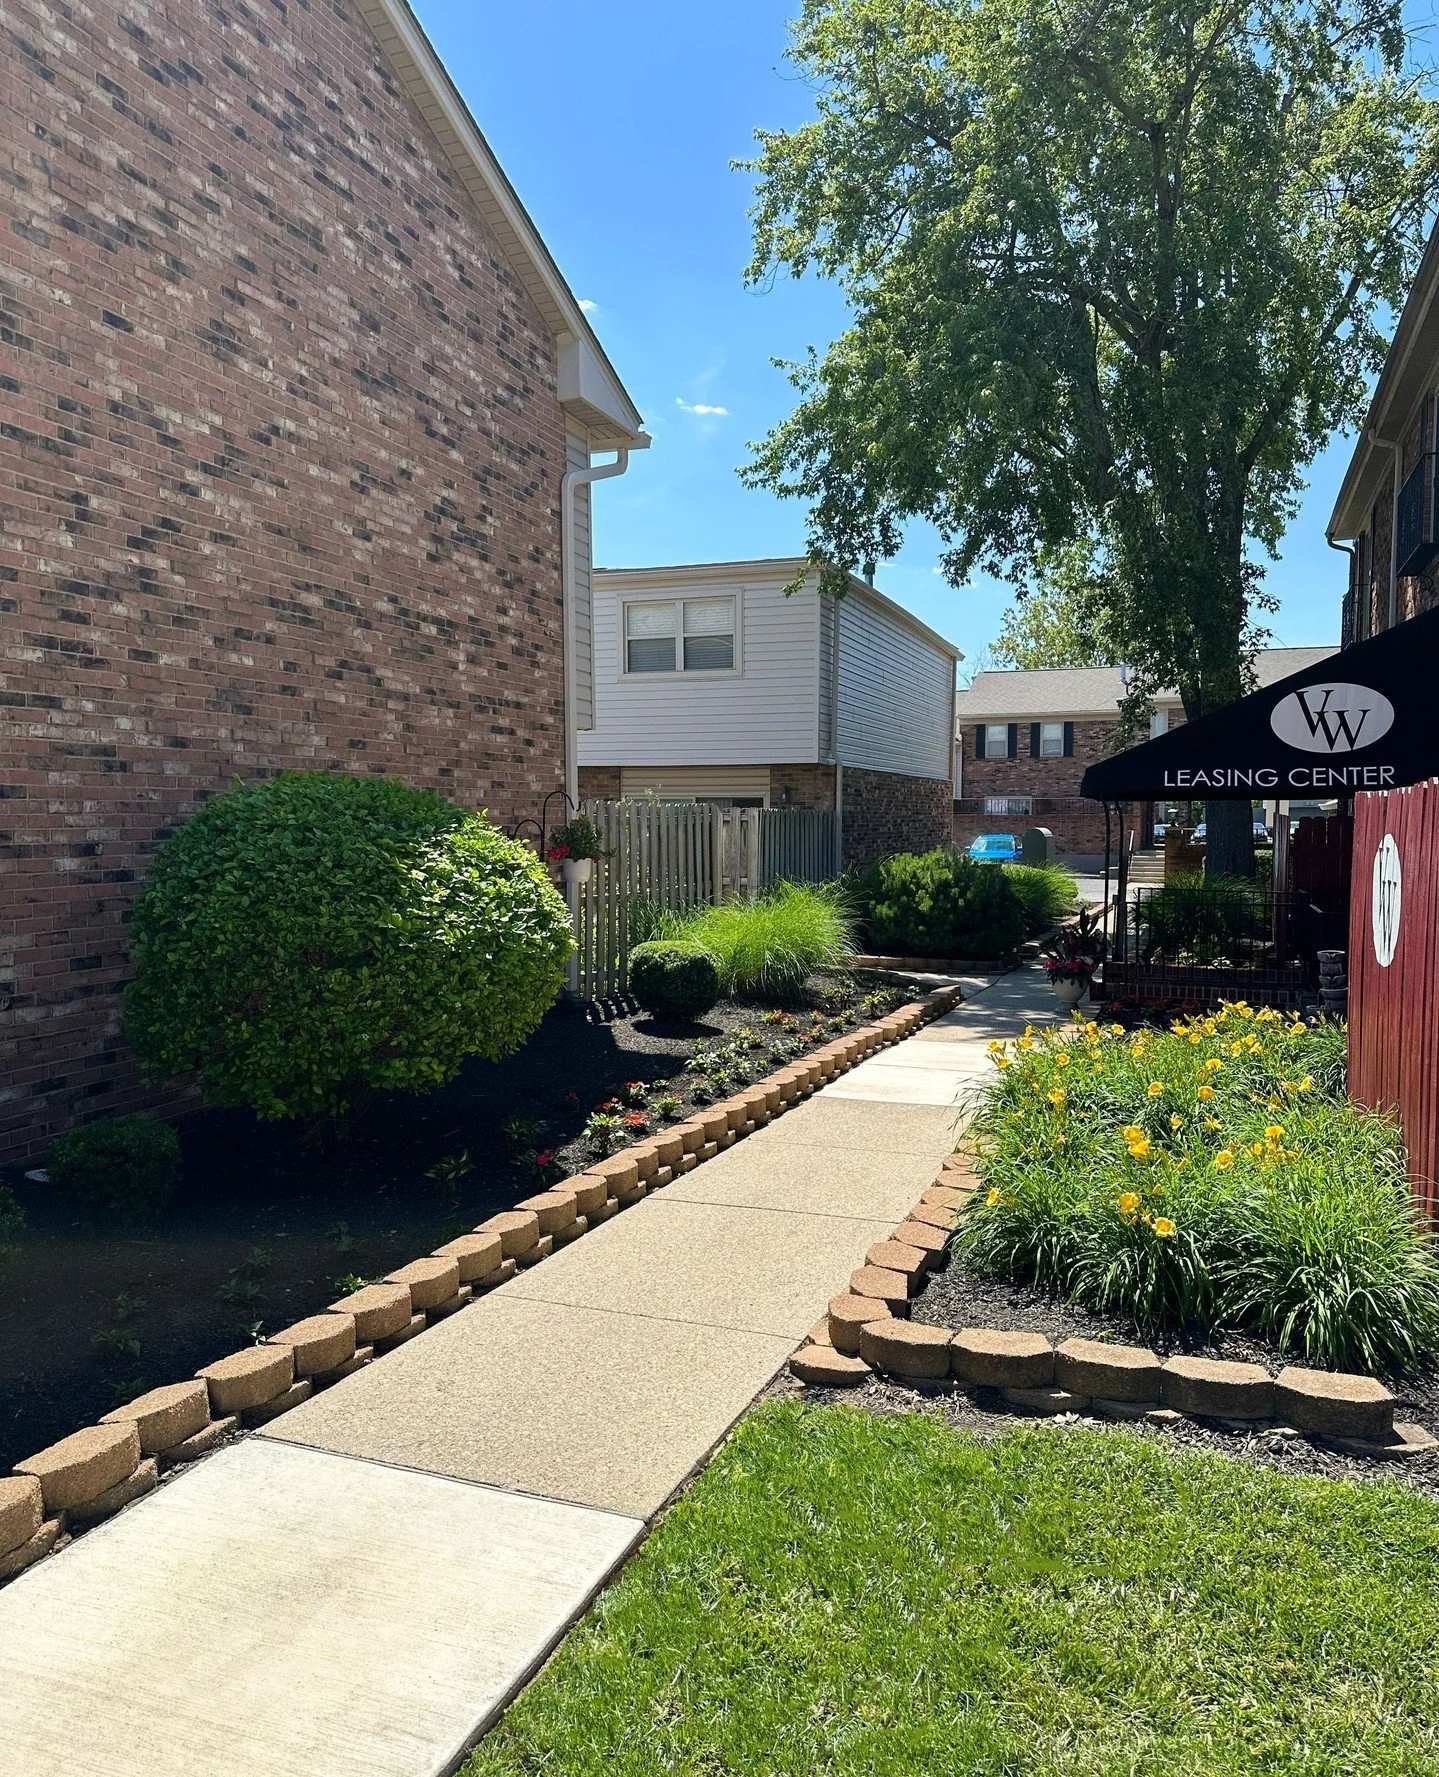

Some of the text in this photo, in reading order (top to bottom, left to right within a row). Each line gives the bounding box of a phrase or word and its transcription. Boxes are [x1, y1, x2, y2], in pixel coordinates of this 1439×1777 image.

[1295, 689, 1371, 751] VW
[1164, 766, 1395, 787] LEASING CENTER
